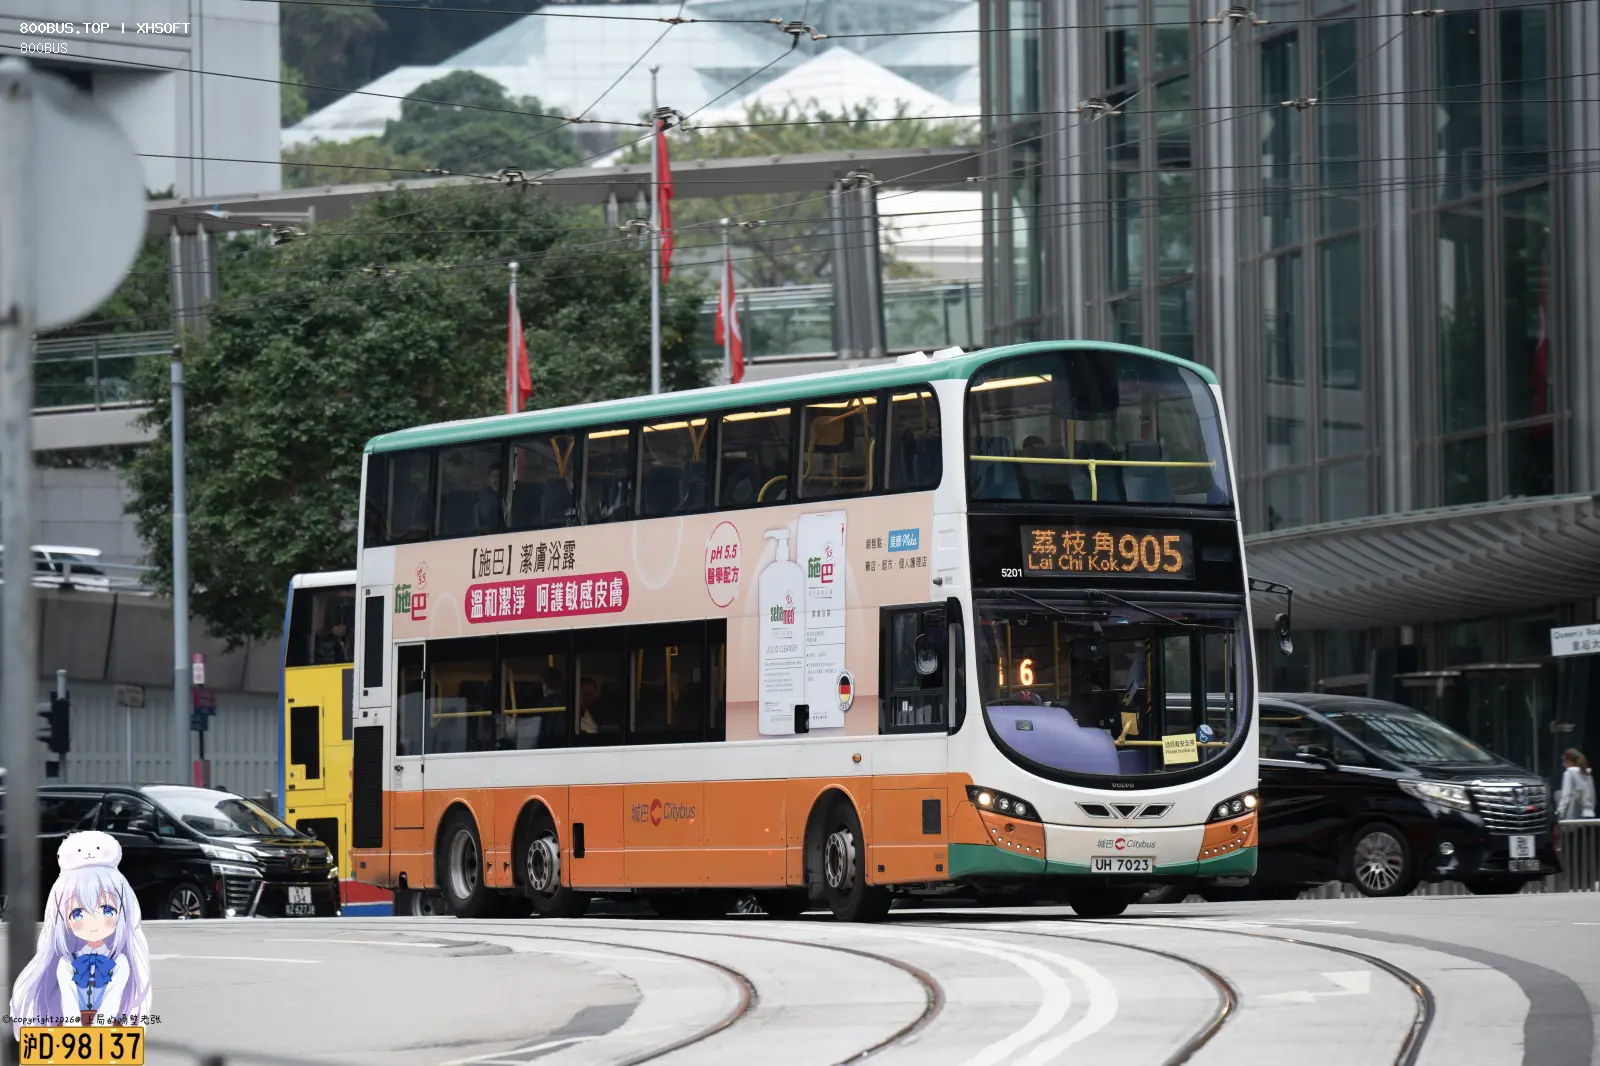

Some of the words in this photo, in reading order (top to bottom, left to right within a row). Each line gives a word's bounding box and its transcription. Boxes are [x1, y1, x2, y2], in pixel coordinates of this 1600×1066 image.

[1031, 529, 1114, 556] 荔枝角
[710, 546, 723, 564] pH
[723, 543, 738, 559] 5.5
[1028, 554, 1053, 570] Lai
[1058, 554, 1083, 571] Chi
[1088, 555, 1120, 572] Kok
[1118, 534, 1184, 573] 905
[707, 567, 740, 585] 醫學配方
[808, 557, 834, 583] 施巴
[1001, 568, 1023, 578] 5201
[395, 584, 428, 621] 施巴
[470, 585, 526, 619] 溫和潔淨
[536, 577, 623, 614] 呵護敏感皮膚
[770, 605, 795, 625] sebamed
[631, 803, 649, 823] 城巴
[663, 801, 697, 822] Citybus
[1097, 839, 1114, 849] 城巴
[1126, 839, 1156, 849] Citybus
[1095, 859, 1112, 871] UH
[1117, 859, 1149, 871] 7023
